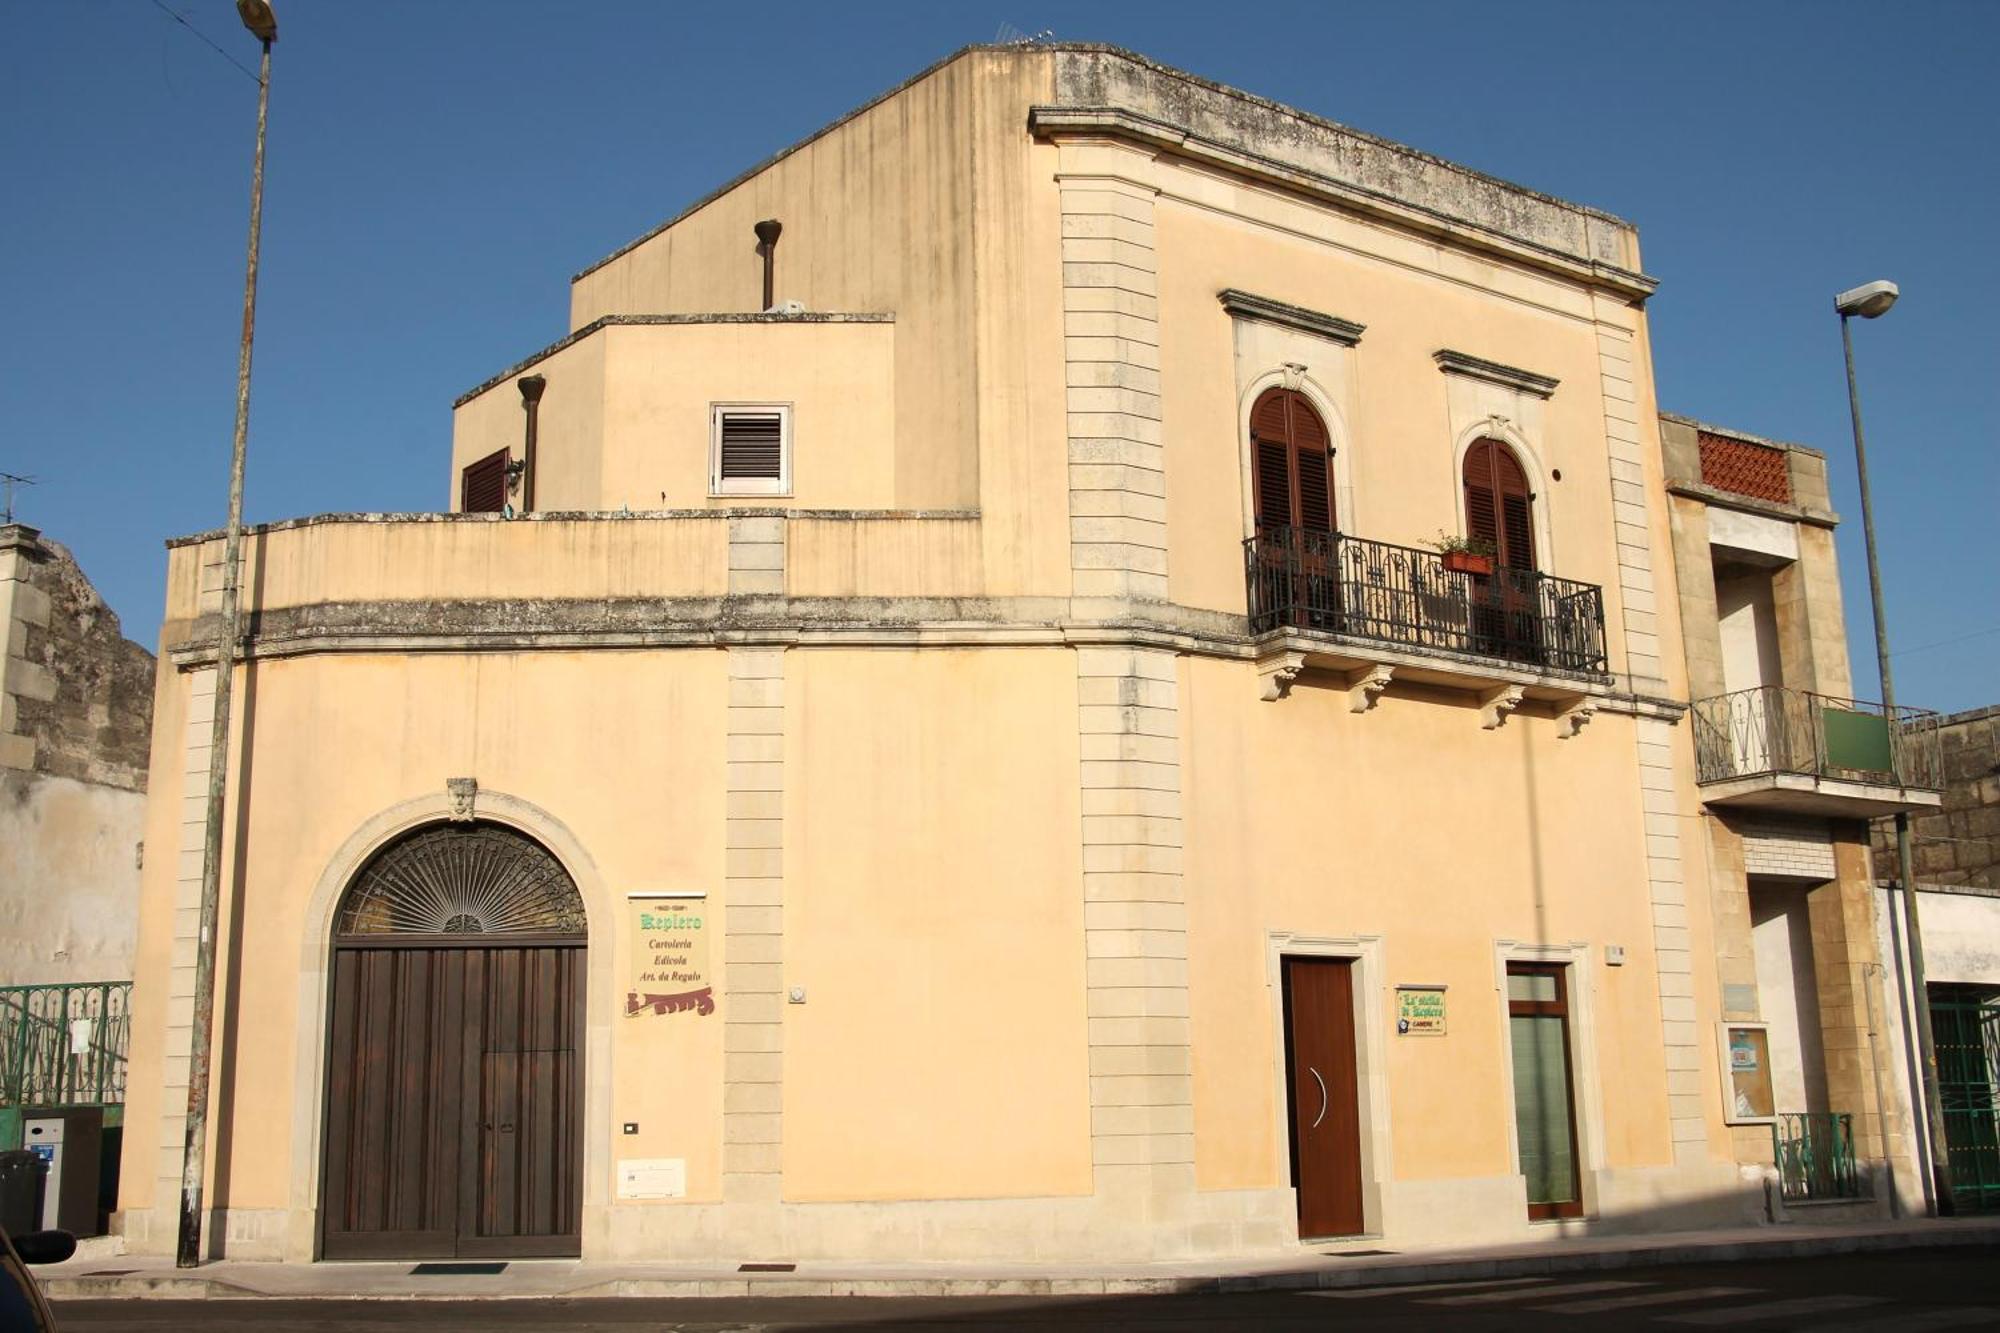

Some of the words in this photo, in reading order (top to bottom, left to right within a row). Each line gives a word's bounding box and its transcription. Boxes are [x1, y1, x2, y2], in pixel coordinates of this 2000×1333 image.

[648, 939, 692, 949] Cartoleria
[654, 955, 687, 965] Edicola
[658, 971, 669, 981] da
[671, 971, 701, 983] Regalo
